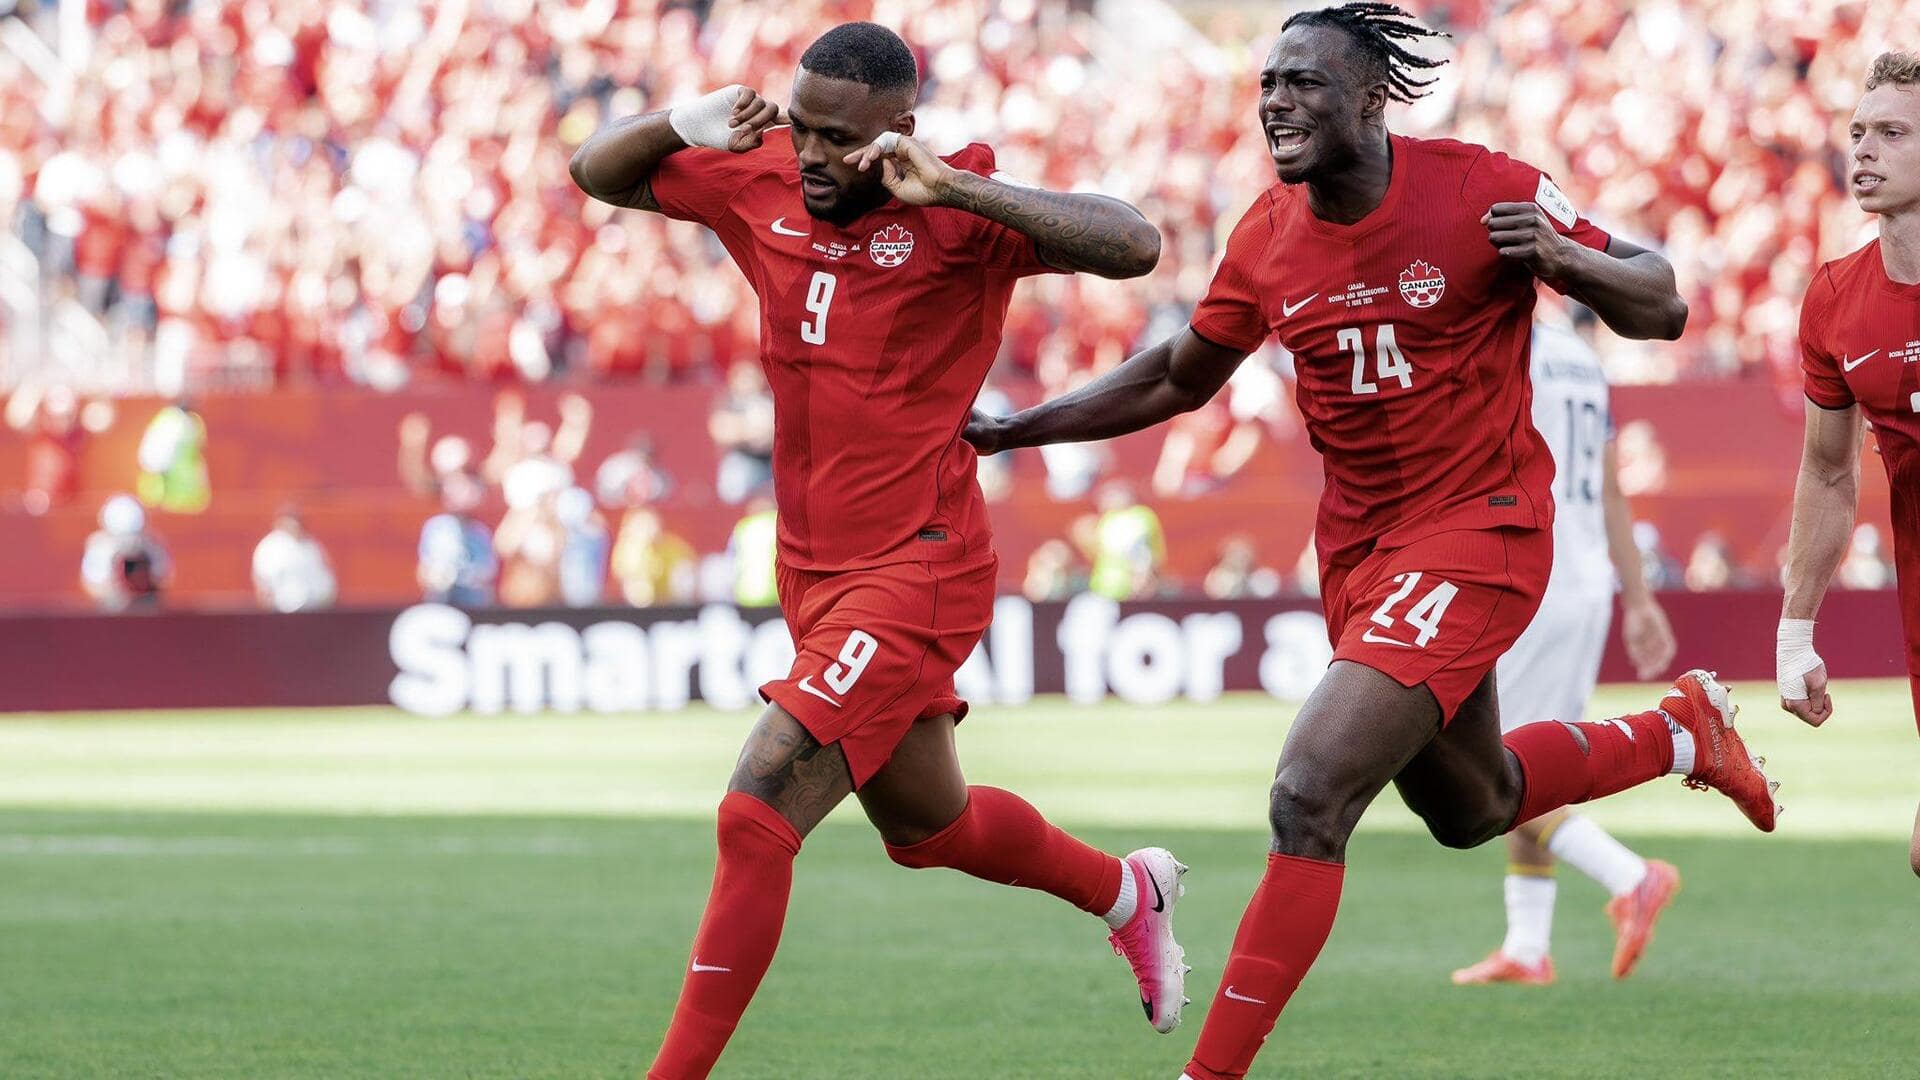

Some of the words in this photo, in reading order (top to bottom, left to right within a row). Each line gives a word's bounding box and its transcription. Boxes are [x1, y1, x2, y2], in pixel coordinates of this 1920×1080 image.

[871, 243, 912, 251] CANADA
[800, 271, 837, 346] 9
[1347, 282, 1366, 291] CANADA
[1400, 279, 1444, 291] CANADA
[1336, 323, 1414, 395] 24
[1369, 571, 1460, 649] 24
[823, 629, 879, 696] 9
[954, 595, 1034, 706] I
[1057, 592, 1242, 704] for
